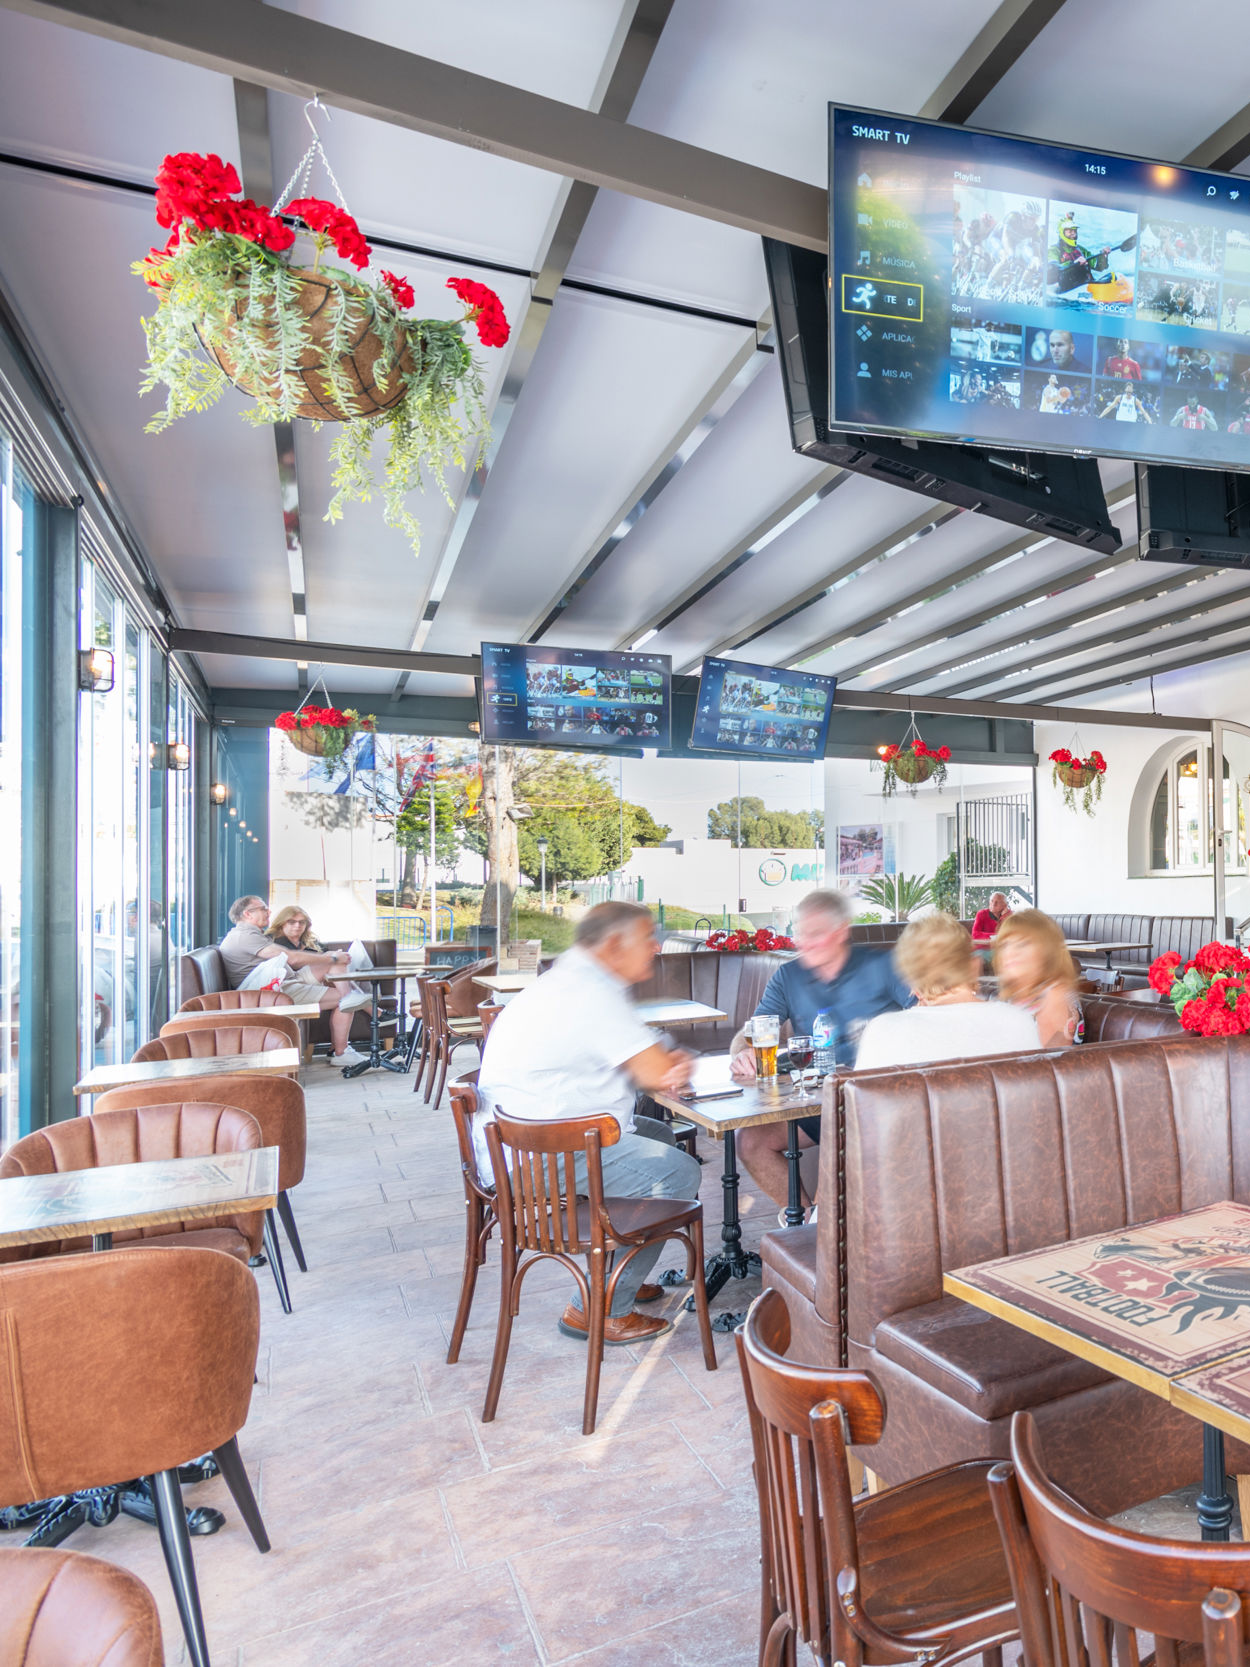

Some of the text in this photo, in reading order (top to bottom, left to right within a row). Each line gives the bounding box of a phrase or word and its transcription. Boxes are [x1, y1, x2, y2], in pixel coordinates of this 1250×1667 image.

[852, 125, 911, 145] SMART TV
[1085, 163, 1106, 175] 14:15
[954, 171, 982, 184] Playlist
[951, 303, 972, 313] Sport
[1098, 301, 1128, 314] Soccer
[882, 368, 897, 378] MIS
[436, 955, 481, 966] HAPPY
[1036, 1270, 1174, 1327] FOOTBALL
